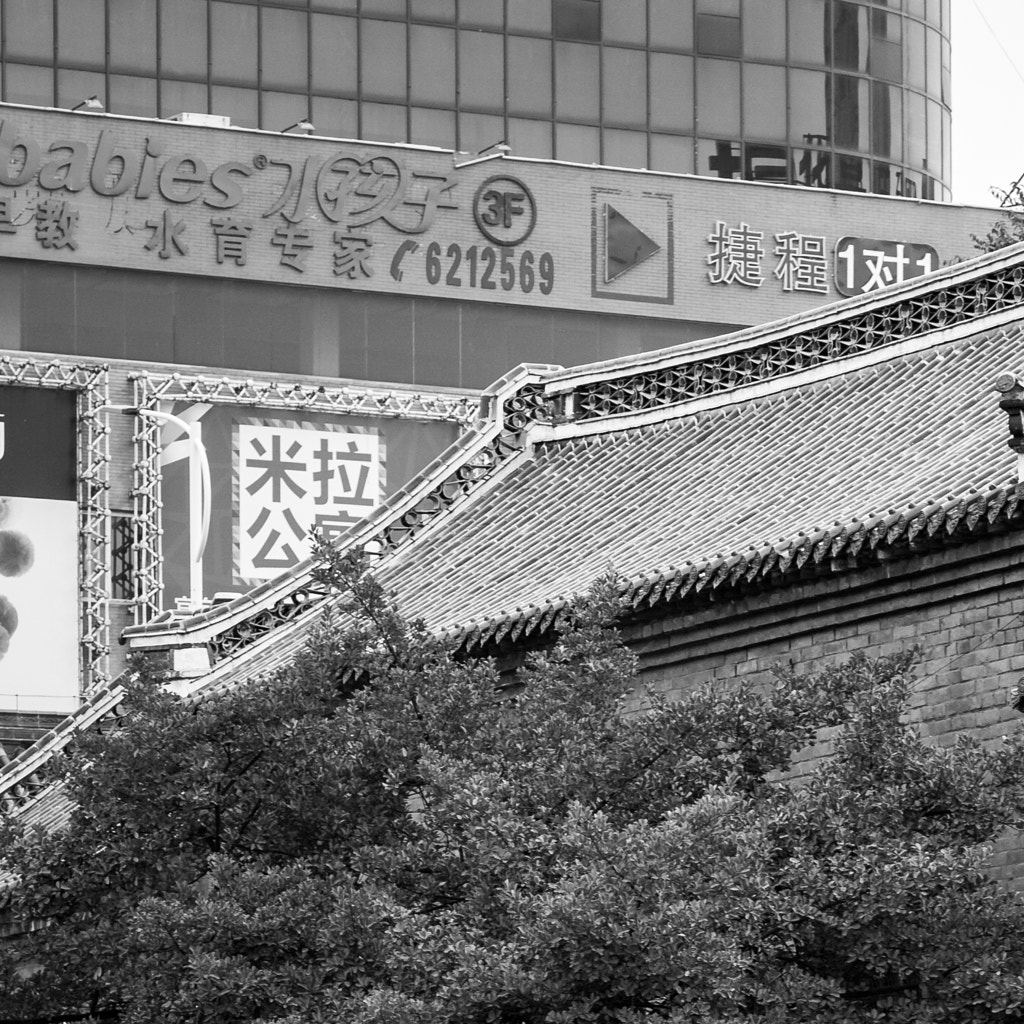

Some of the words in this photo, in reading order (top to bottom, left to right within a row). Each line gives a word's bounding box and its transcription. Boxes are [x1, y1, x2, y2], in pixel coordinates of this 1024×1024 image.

[482, 188, 524, 229] 3F
[425, 241, 554, 295] 6212569
[707, 220, 831, 295] 捷程
[245, 435, 374, 507] 米拉
